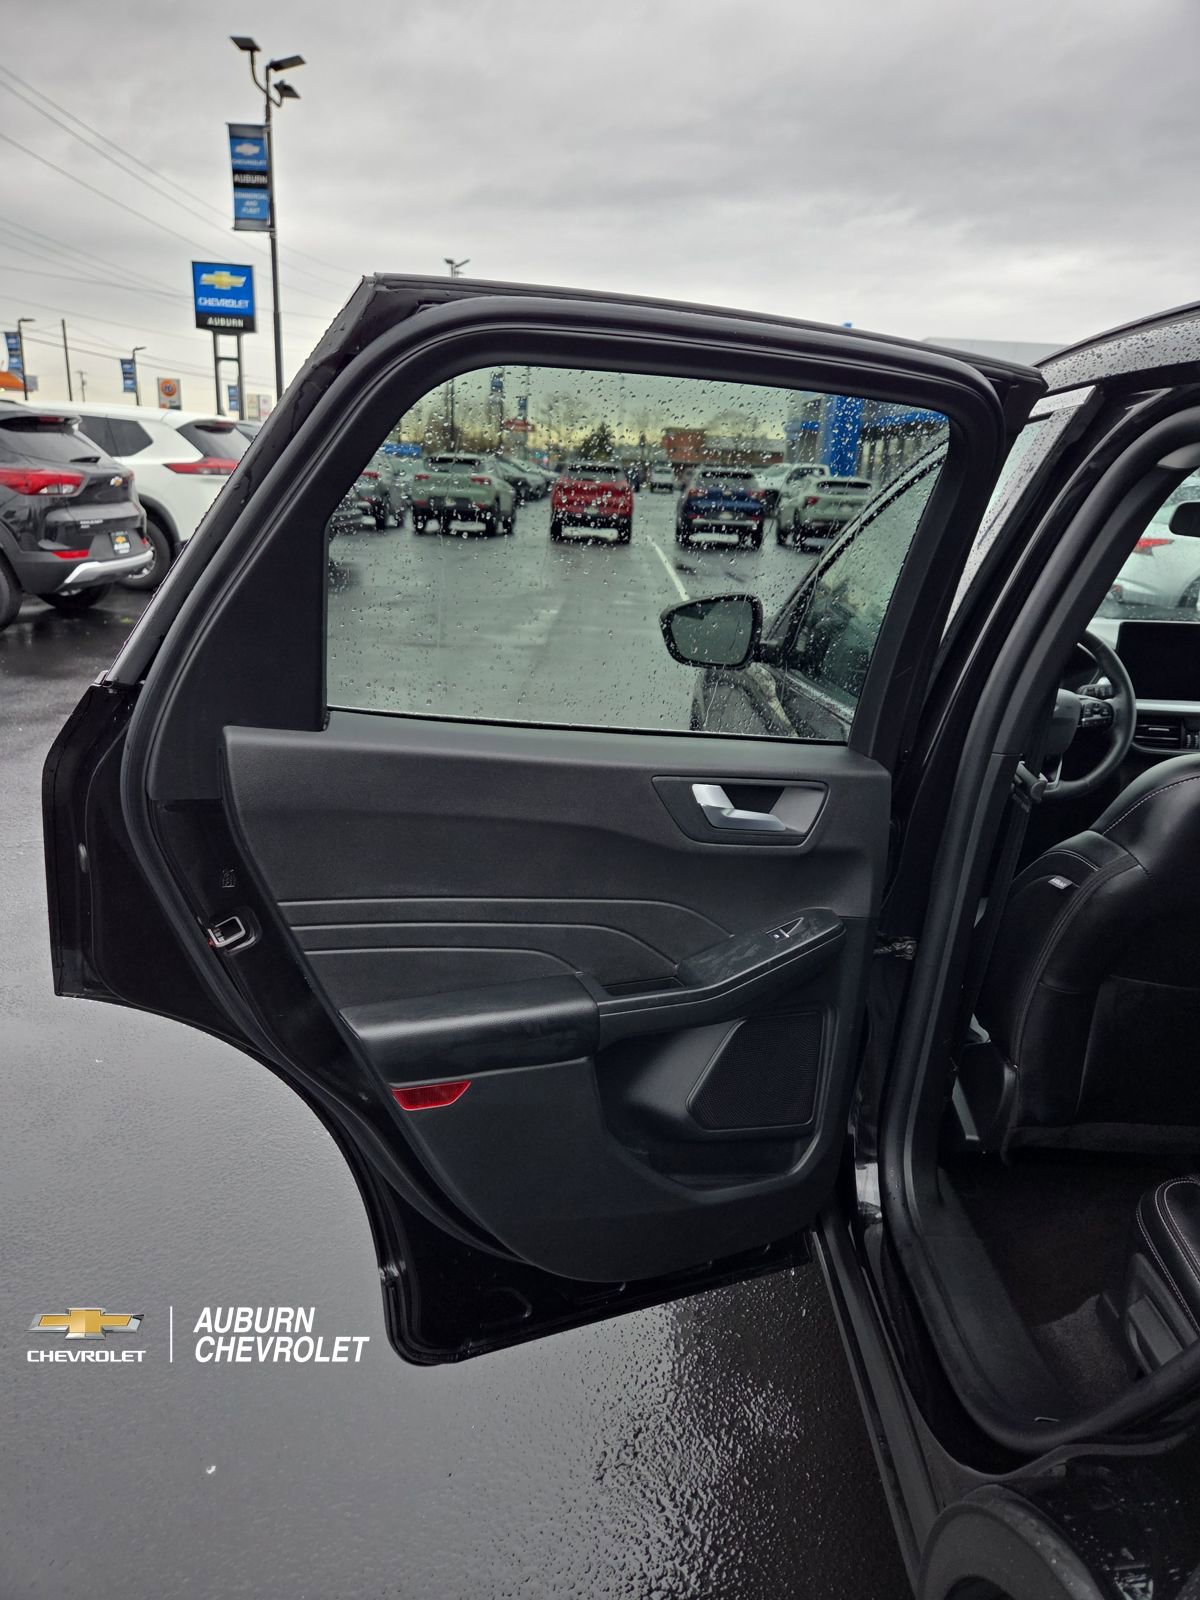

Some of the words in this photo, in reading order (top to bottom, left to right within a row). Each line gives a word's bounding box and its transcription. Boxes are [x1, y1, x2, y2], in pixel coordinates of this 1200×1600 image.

[234, 174, 268, 184] AUBURN
[198, 296, 249, 309] CHEVROLET
[207, 316, 244, 328] AUBURN
